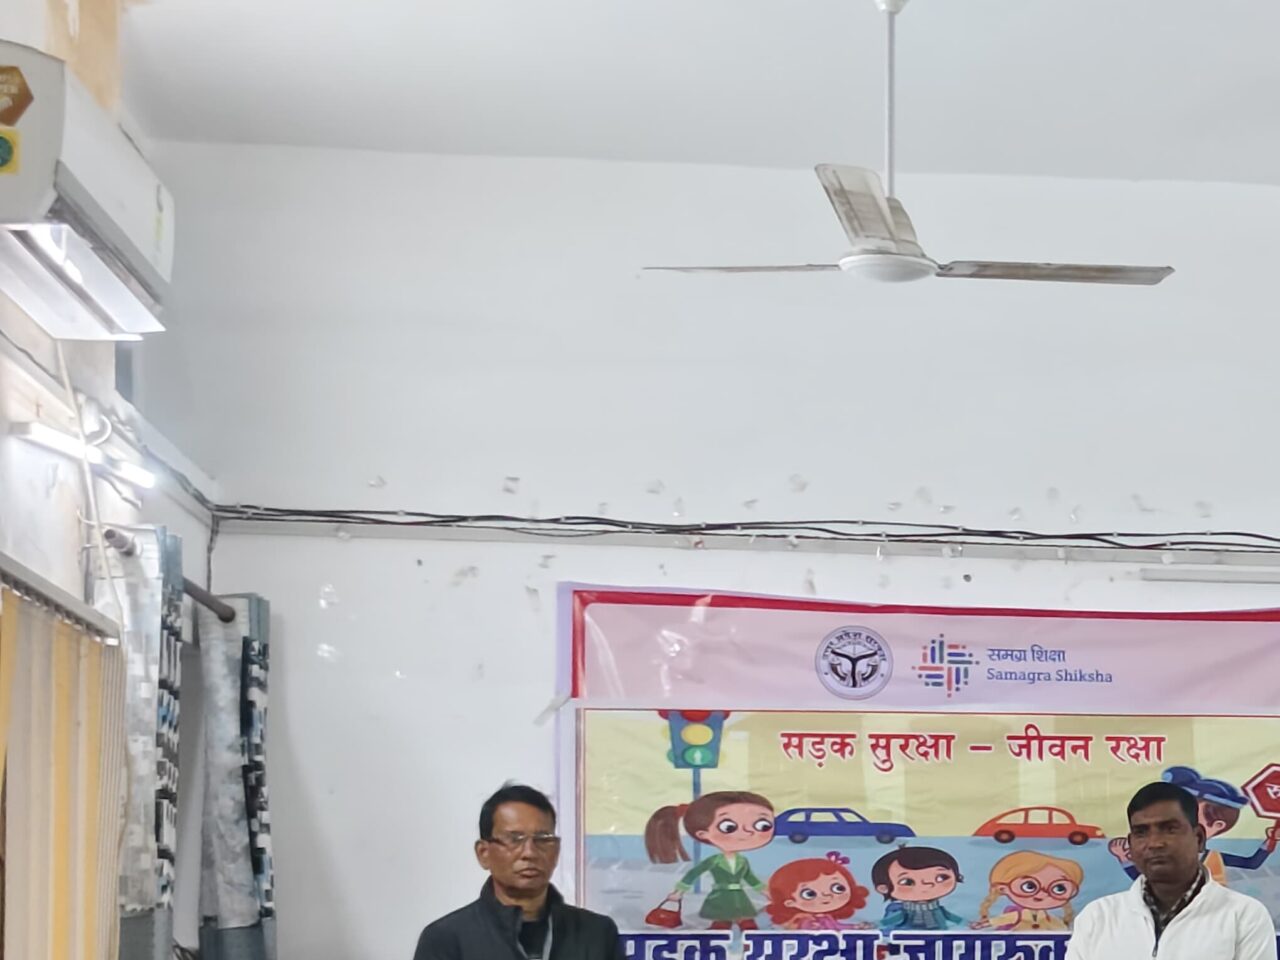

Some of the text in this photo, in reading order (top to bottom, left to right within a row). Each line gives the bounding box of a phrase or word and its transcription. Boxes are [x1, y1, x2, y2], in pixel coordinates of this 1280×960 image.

[987, 644, 1066, 662] समग्र शिक्षा
[986, 667, 1113, 685] Samagra Shiksha
[781, 732, 856, 768] सड़क
[868, 733, 956, 772] सुरक्षा
[1006, 724, 1093, 762] जीवन
[1105, 736, 1167, 763] रक्षा
